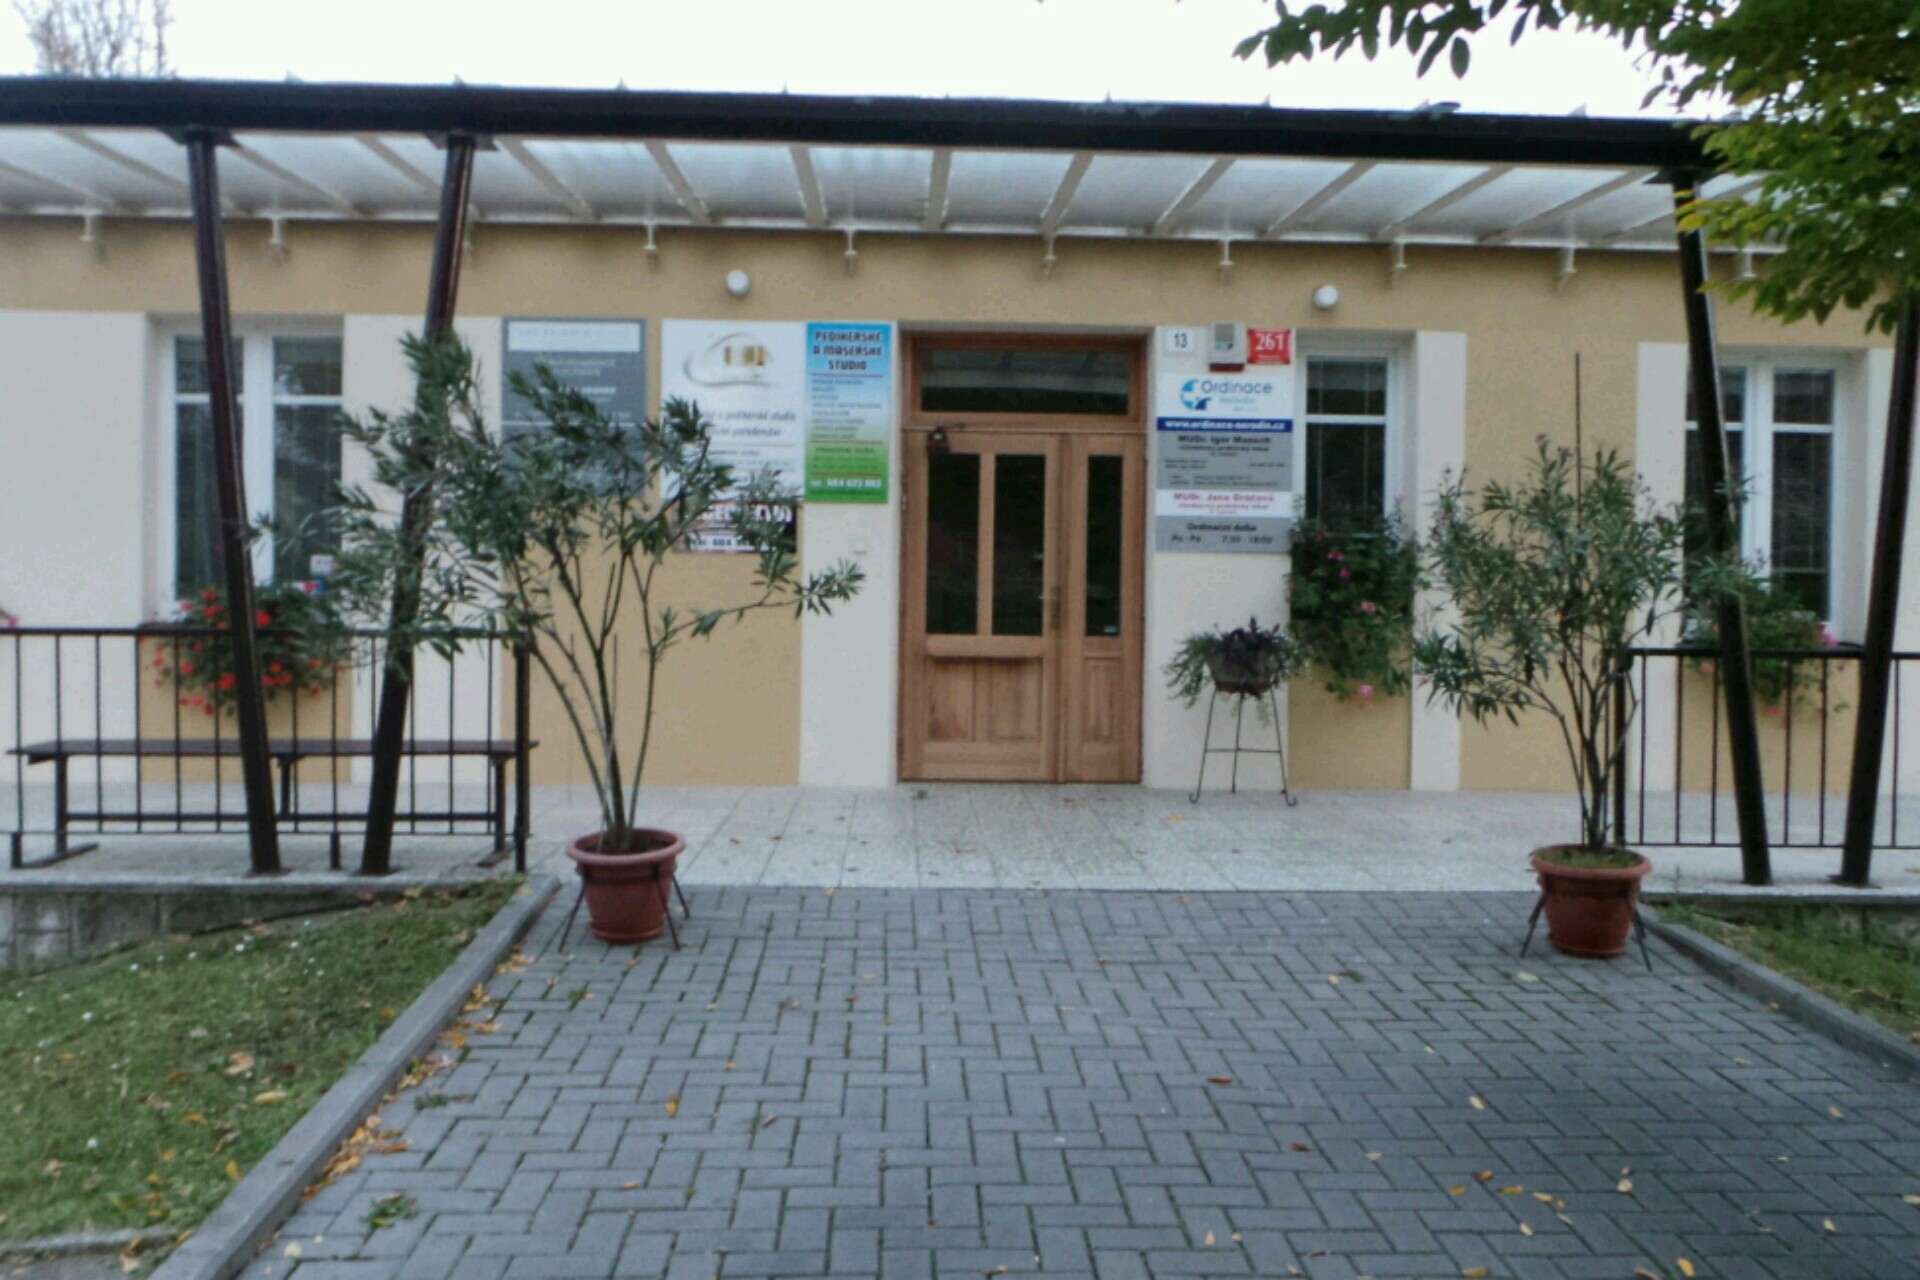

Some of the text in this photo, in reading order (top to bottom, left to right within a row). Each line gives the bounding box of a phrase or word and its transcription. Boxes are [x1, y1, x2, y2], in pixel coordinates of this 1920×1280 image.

[1174, 333, 1188, 348] 13
[1255, 332, 1285, 351] 261
[828, 360, 867, 370] STUDIO
[1201, 380, 1273, 394] Ordinace
[1210, 435, 1230, 445] Igor
[1207, 493, 1230, 501] Jana
[1234, 523, 1257, 532] doba
[1171, 534, 1183, 543] Po
